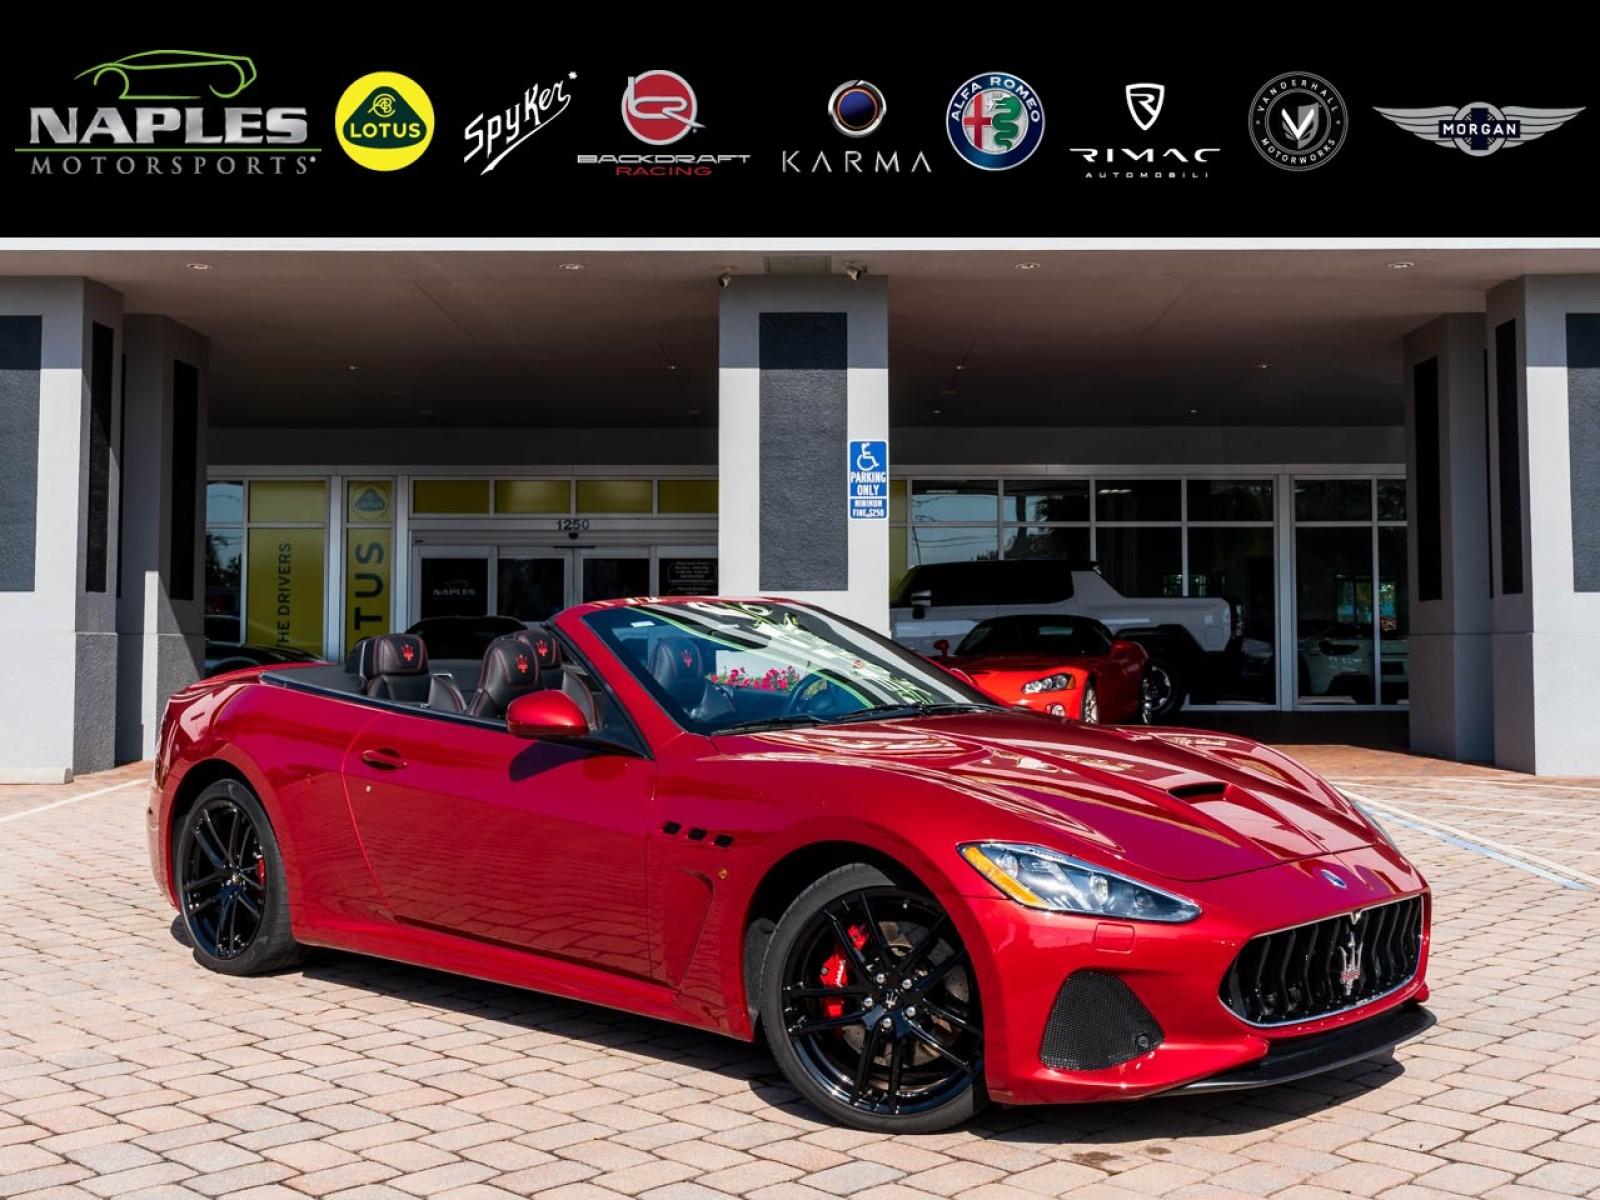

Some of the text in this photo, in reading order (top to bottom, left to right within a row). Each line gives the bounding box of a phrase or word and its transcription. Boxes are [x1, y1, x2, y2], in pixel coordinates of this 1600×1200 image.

[850, 471, 887, 483] PARKING
[857, 484, 880, 496] ONLY
[556, 519, 590, 531] 1250
[276, 542, 292, 648] HE DRIVERS
[354, 541, 384, 640] TUS
